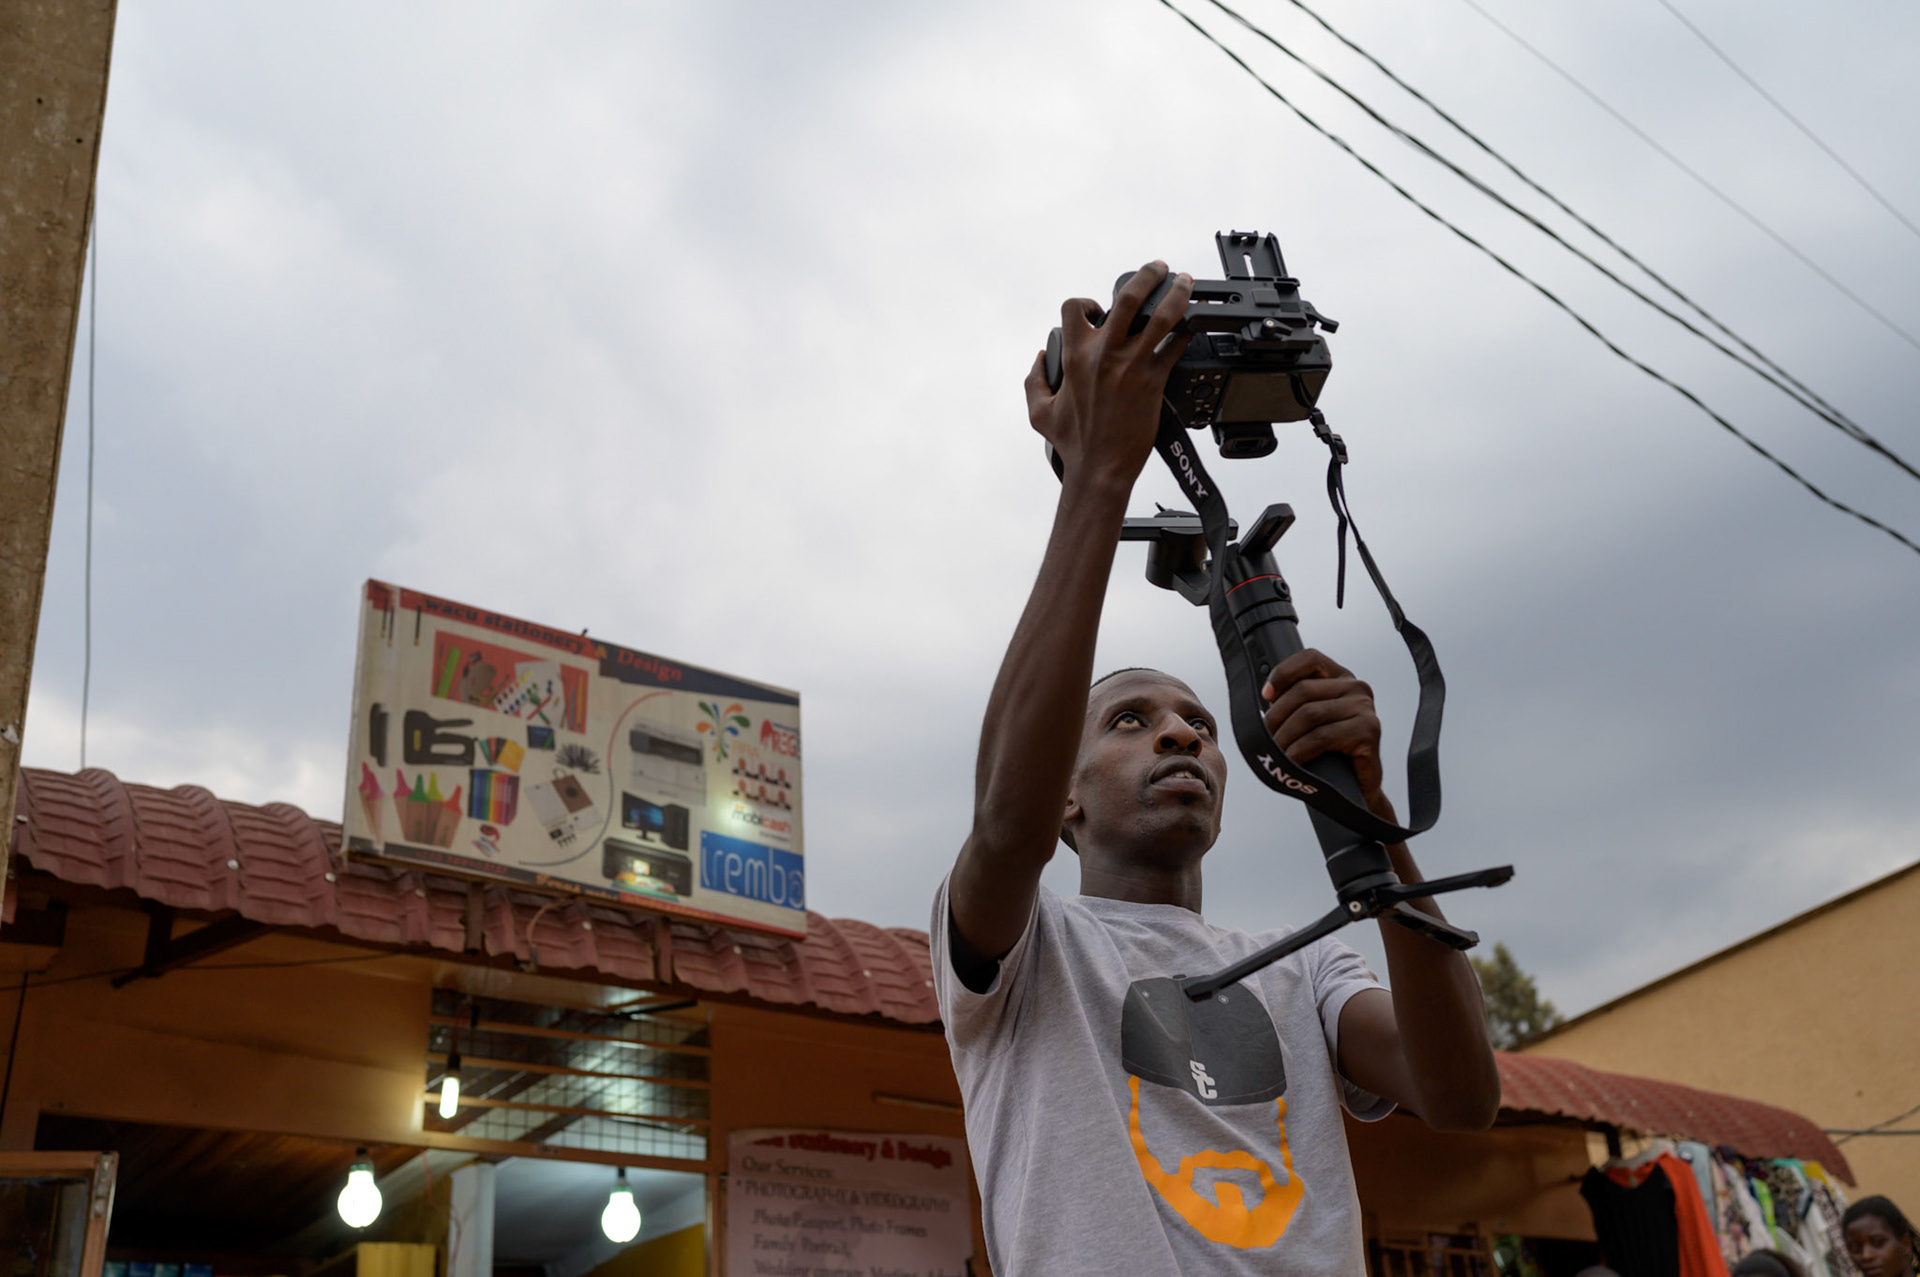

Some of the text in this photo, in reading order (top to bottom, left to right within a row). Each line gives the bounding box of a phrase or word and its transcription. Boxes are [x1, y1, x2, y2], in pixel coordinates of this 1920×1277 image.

[1170, 441, 1209, 498] SONY
[617, 650, 683, 682] Design
[1256, 753, 1319, 794] SONY
[741, 1155, 772, 1172] Our
[881, 1139, 894, 1159] &
